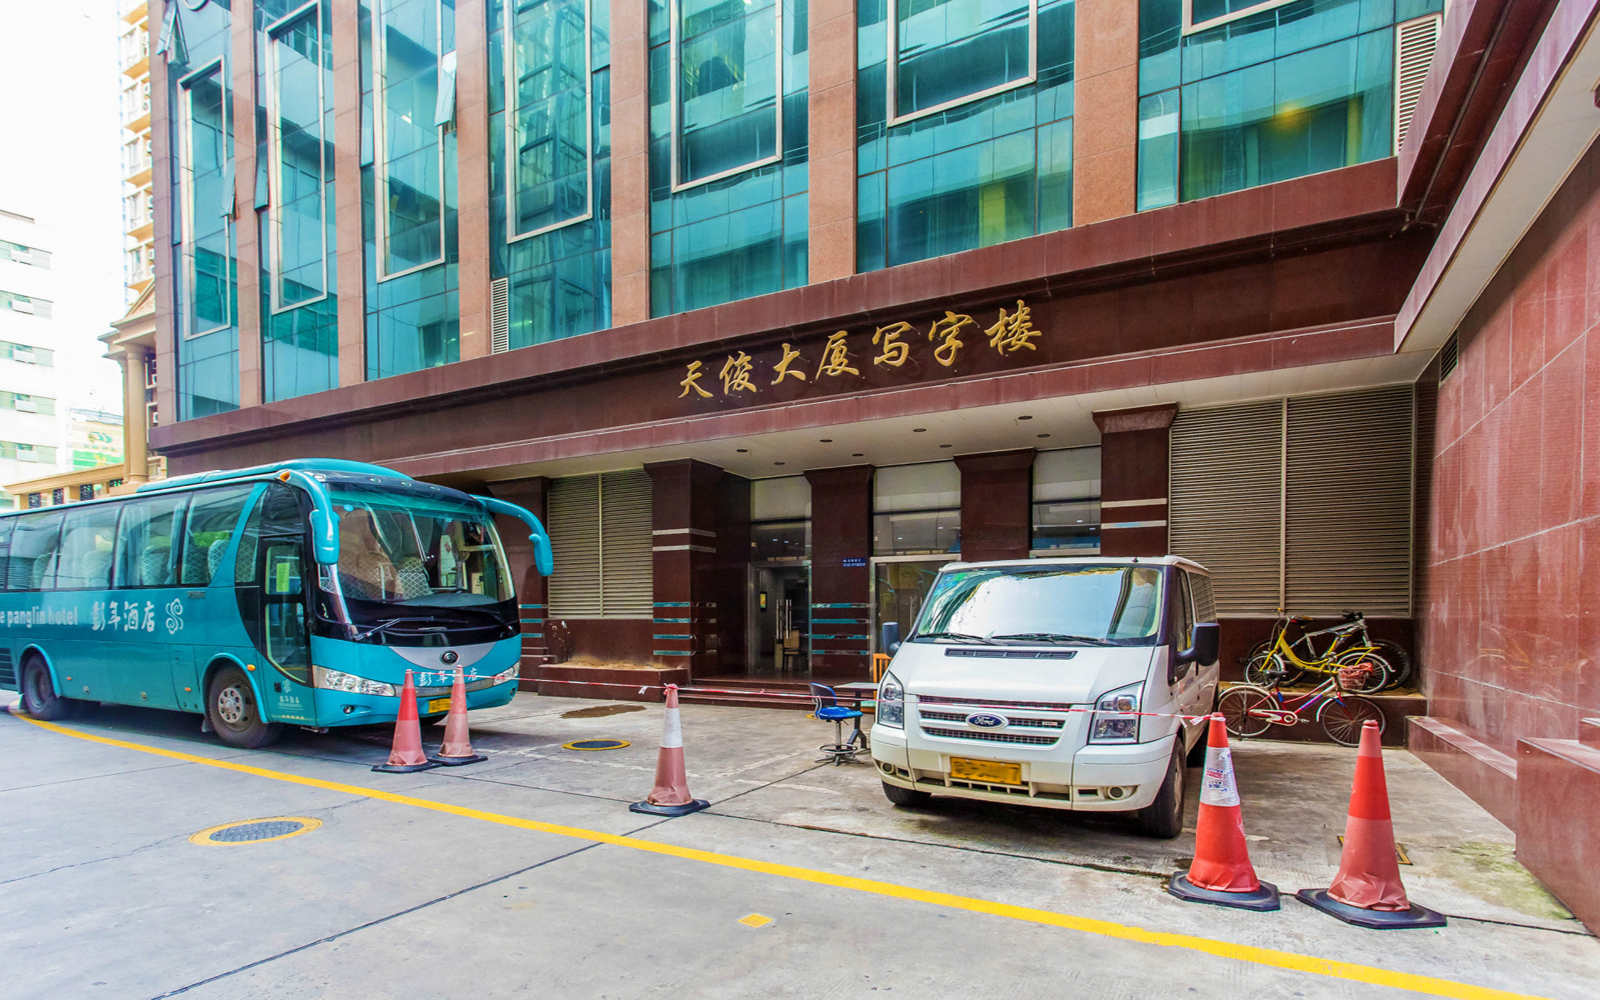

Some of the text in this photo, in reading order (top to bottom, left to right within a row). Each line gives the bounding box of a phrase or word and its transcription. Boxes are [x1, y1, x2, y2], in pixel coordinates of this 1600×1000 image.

[678, 299, 1042, 399] 天俊大厦写字楼
[7, 606, 46, 628] panglin
[48, 606, 78, 625] hotel
[91, 600, 155, 632] 彭年酒店
[418, 667, 477, 686] 彭年店
[974, 714, 995, 726] Ford
